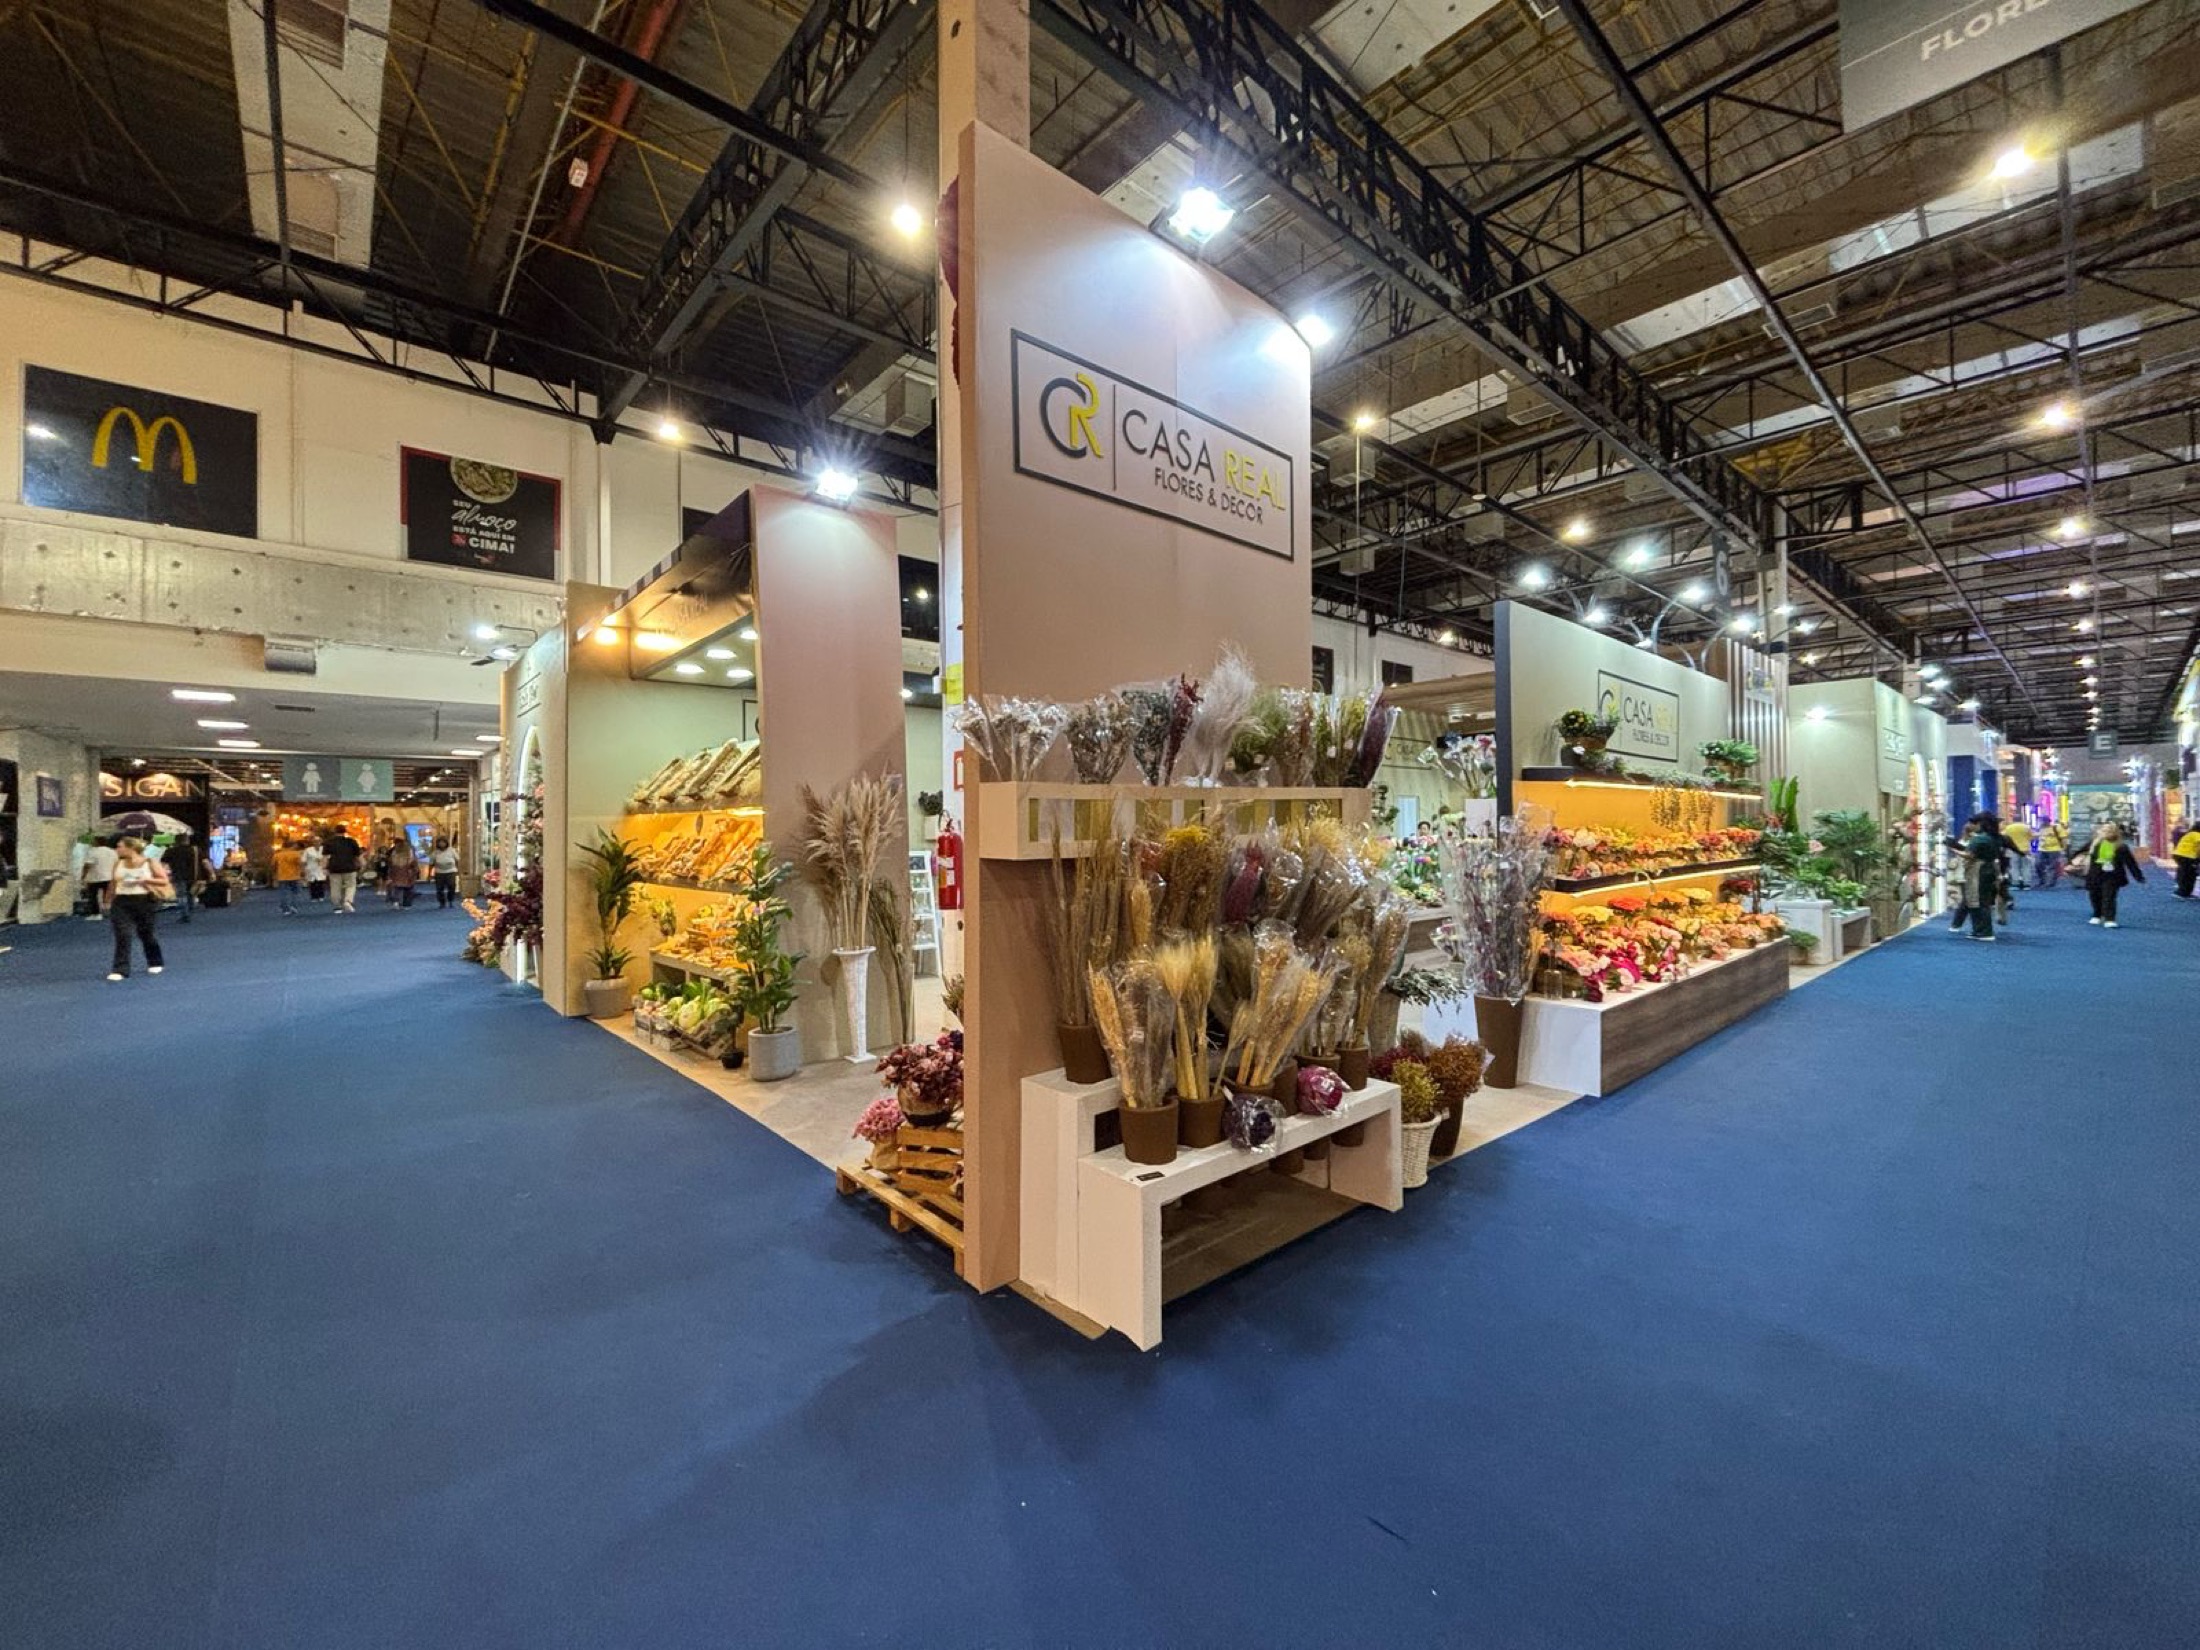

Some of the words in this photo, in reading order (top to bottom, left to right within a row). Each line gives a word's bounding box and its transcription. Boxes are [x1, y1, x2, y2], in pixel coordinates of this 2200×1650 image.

[1121, 408, 1215, 483] CASA
[1223, 448, 1286, 512] REAL
[1154, 466, 1204, 503] FLORES
[1206, 487, 1217, 508] &
[1220, 492, 1263, 525] DECOR
[468, 537, 515, 554] CIMA!
[1624, 696, 1655, 729] CASA
[2095, 734, 2113, 751] E
[103, 778, 206, 798] SIGAN
